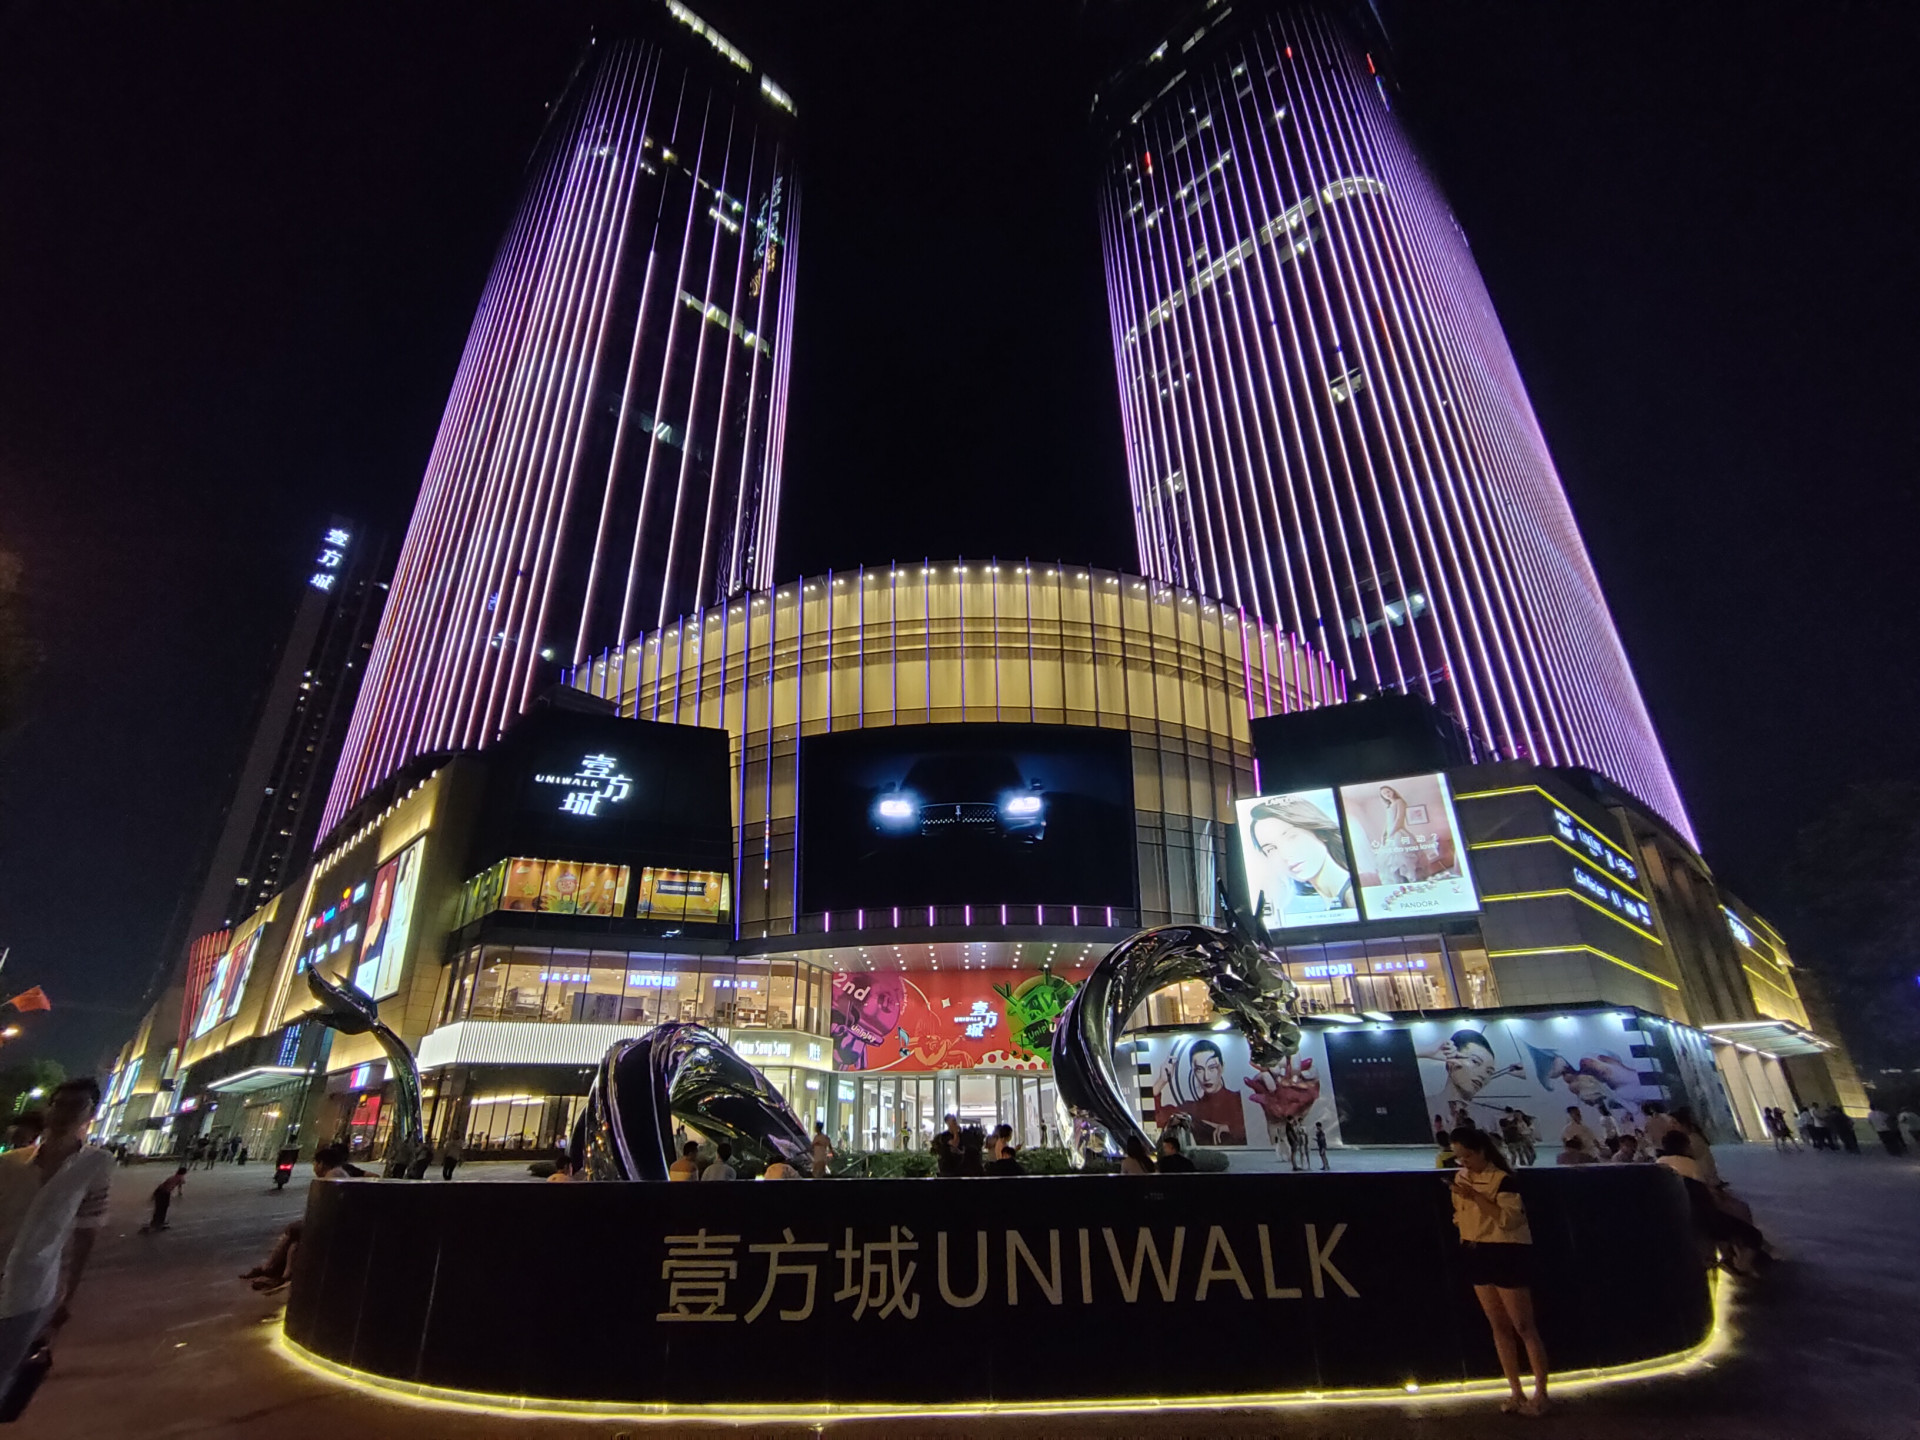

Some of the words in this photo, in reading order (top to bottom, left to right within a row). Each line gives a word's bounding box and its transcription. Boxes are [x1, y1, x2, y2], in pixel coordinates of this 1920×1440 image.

[310, 528, 350, 590] 壹方城
[535, 774, 599, 788] UNIWALK
[1400, 900, 1440, 909] PANDORA
[629, 974, 677, 987] NITORI
[1304, 963, 1354, 978] NITORI
[833, 972, 871, 1001] 2nd
[656, 1225, 921, 1324] 壹方城
[936, 1222, 1361, 1309] UNIWALK
